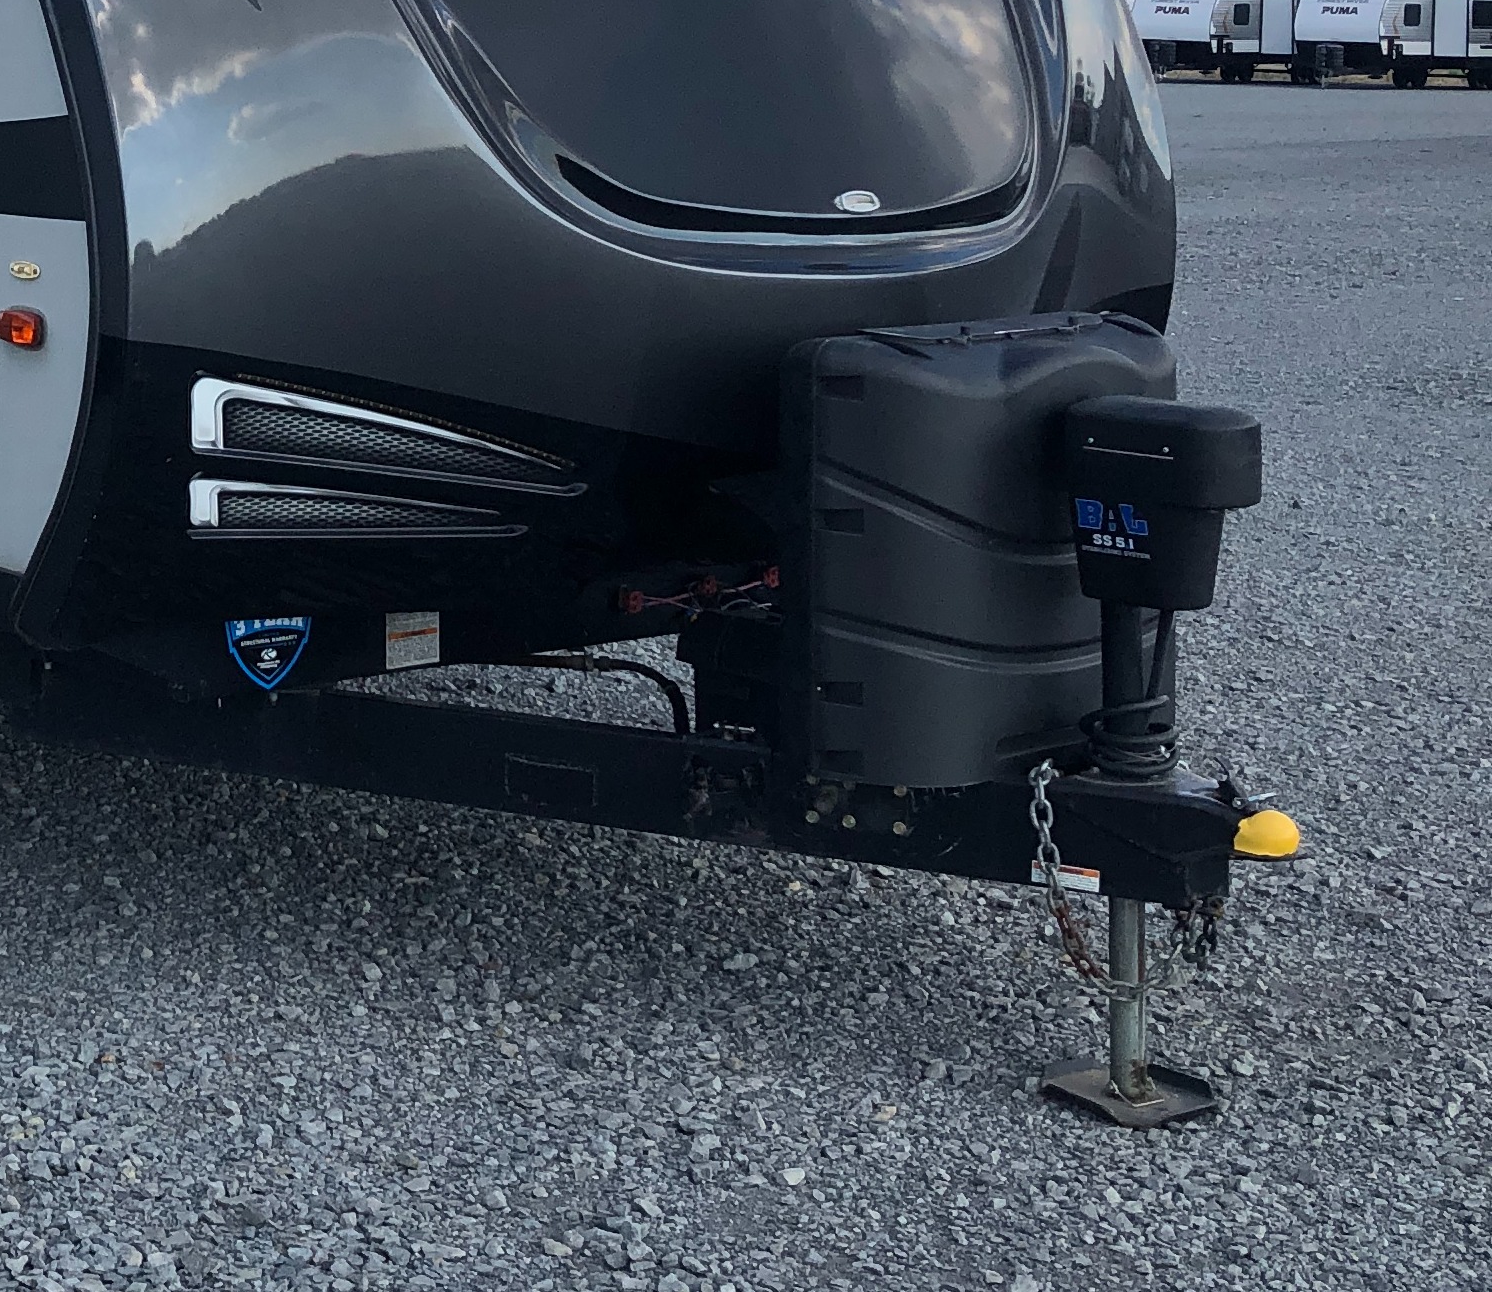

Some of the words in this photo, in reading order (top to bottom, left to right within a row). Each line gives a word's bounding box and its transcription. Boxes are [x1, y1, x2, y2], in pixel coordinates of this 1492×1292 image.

[1154, 5, 1190, 15] PUMA
[1321, 6, 1358, 15] PUMA
[1092, 533, 1113, 547] SS
